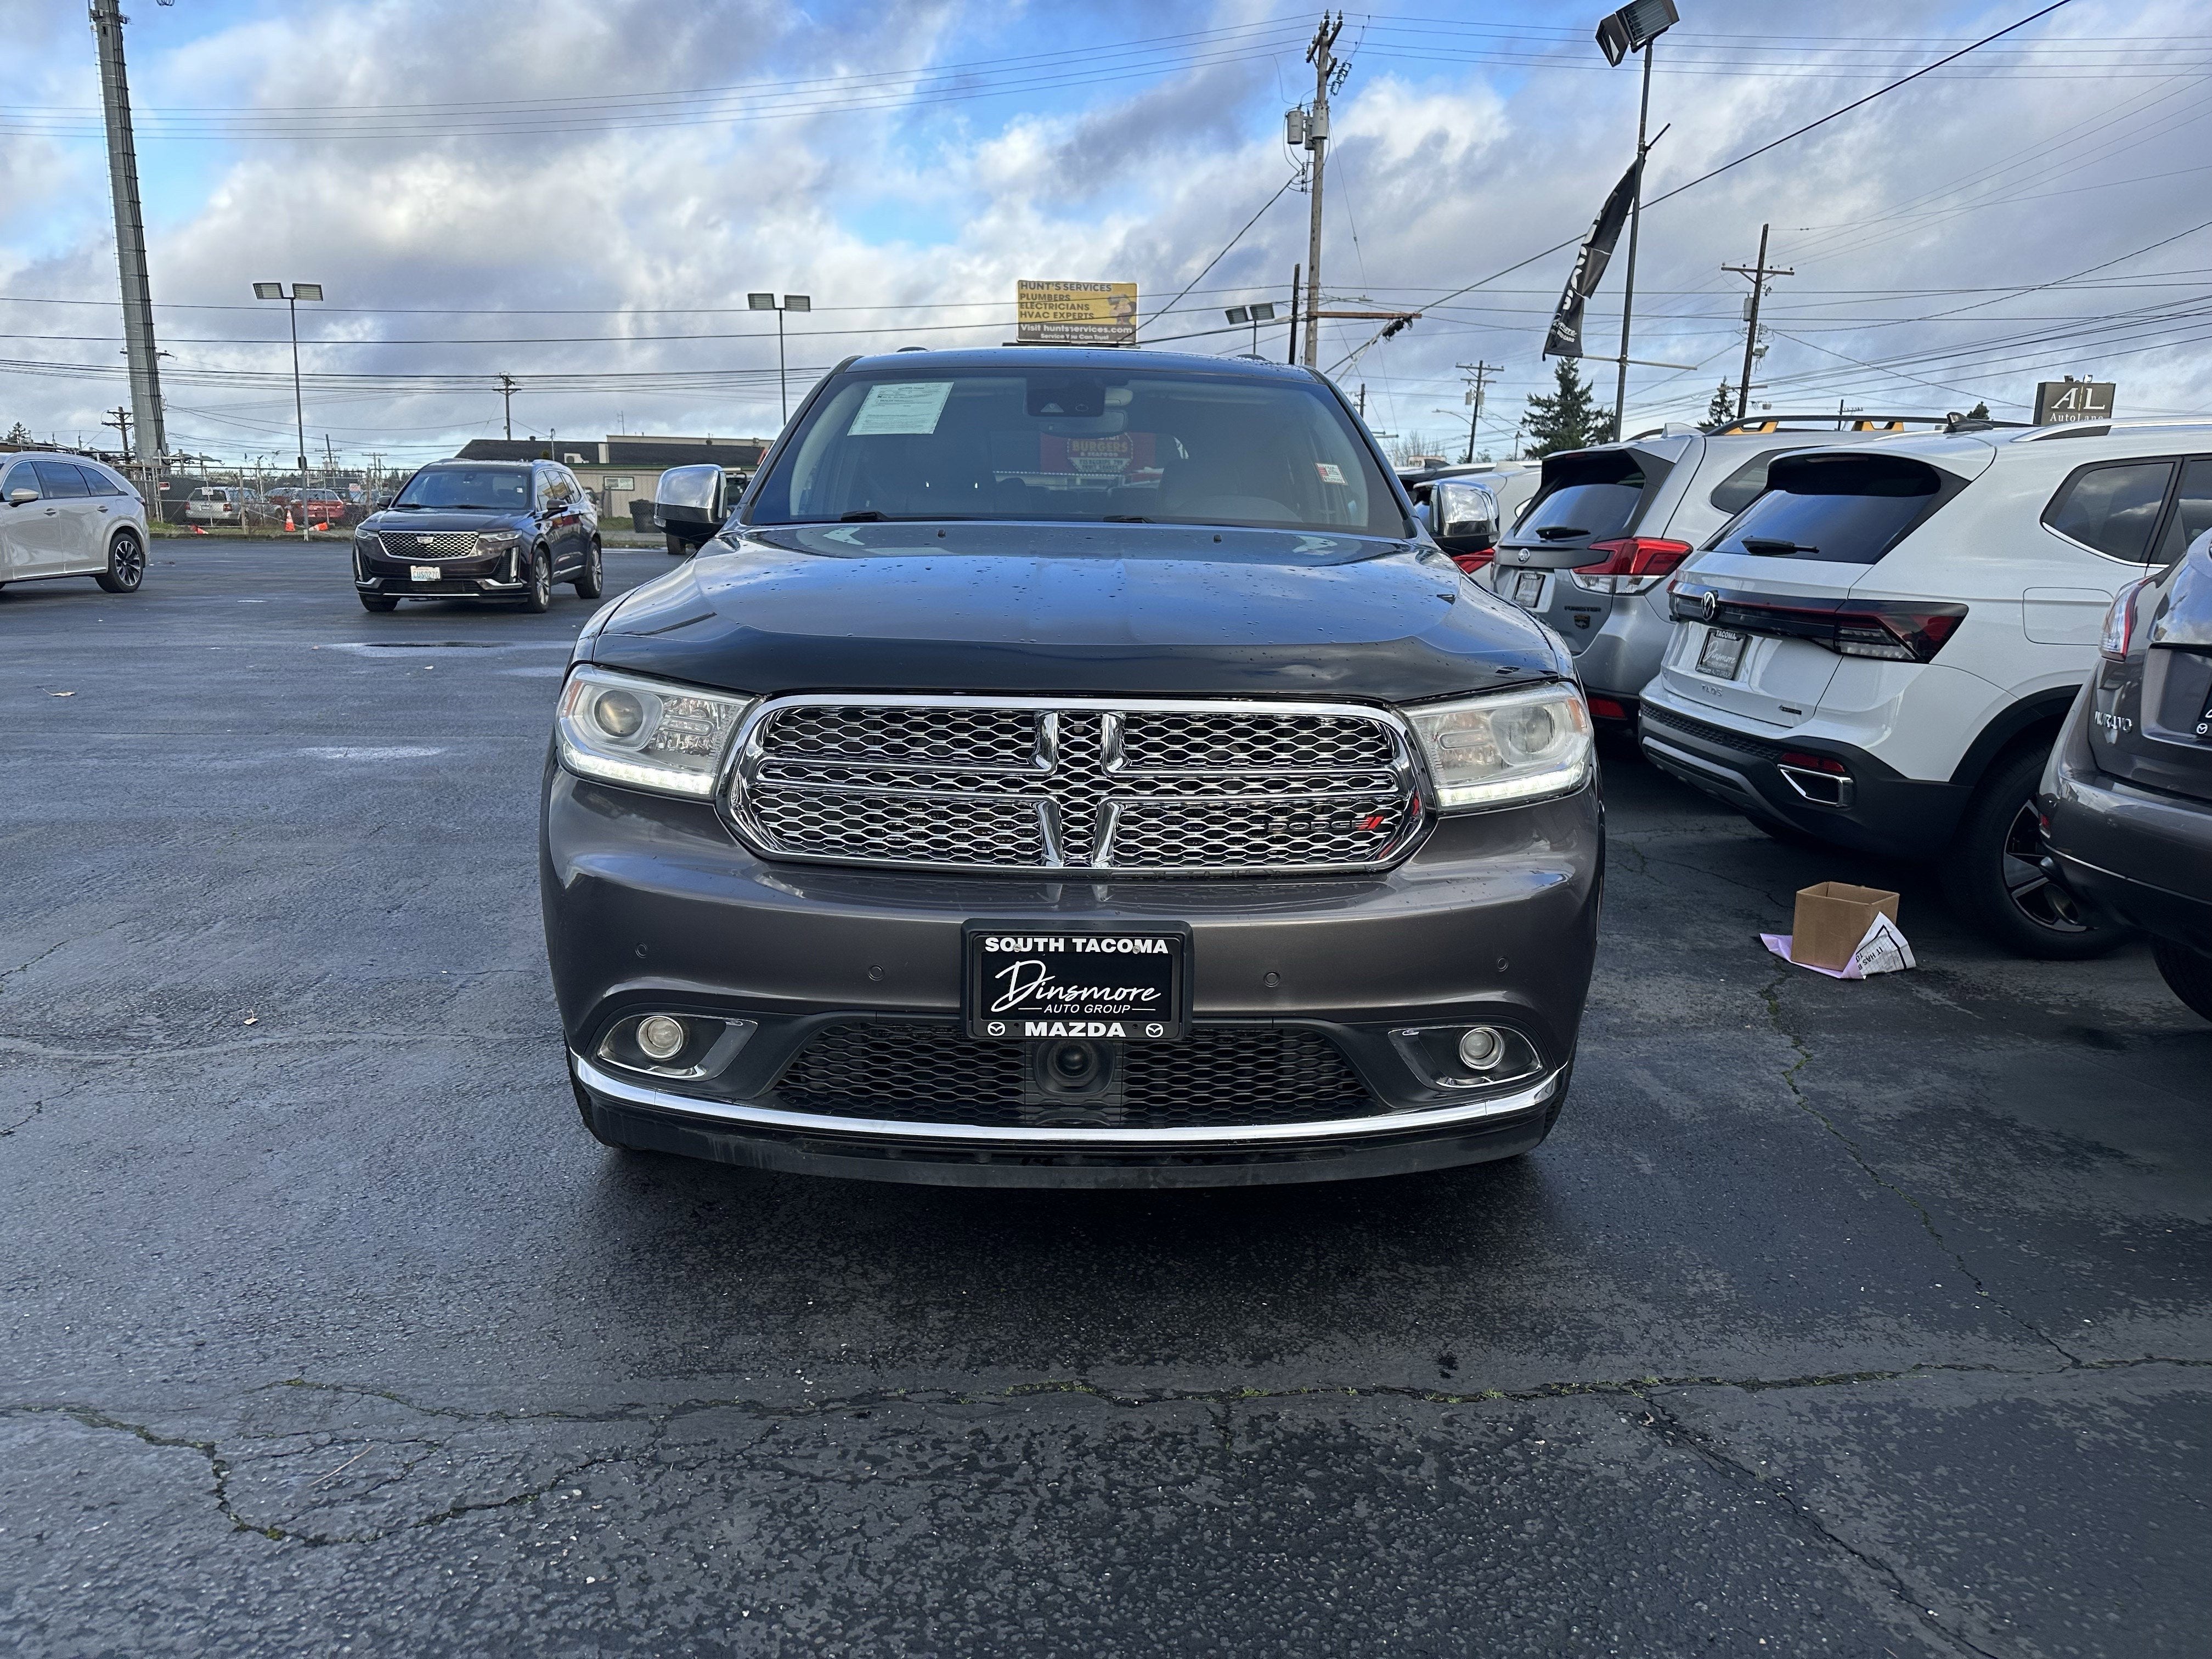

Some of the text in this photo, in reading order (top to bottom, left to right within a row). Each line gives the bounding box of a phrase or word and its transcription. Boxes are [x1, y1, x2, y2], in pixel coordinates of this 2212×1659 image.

[1020, 282, 1111, 292] HUNT'S SERVICES
[1020, 293, 1070, 301] PLUMBERS
[1072, 440, 1128, 452] BURGERS
[1716, 630, 1737, 640] TACOMA
[1268, 820, 1369, 832] DODGE
[985, 937, 1169, 953] SOUTH TACOMA
[991, 960, 1161, 1012] Dinsmore
[1044, 1004, 1131, 1014] AUTO GROUP
[1024, 1022, 1126, 1037] MAZDA
